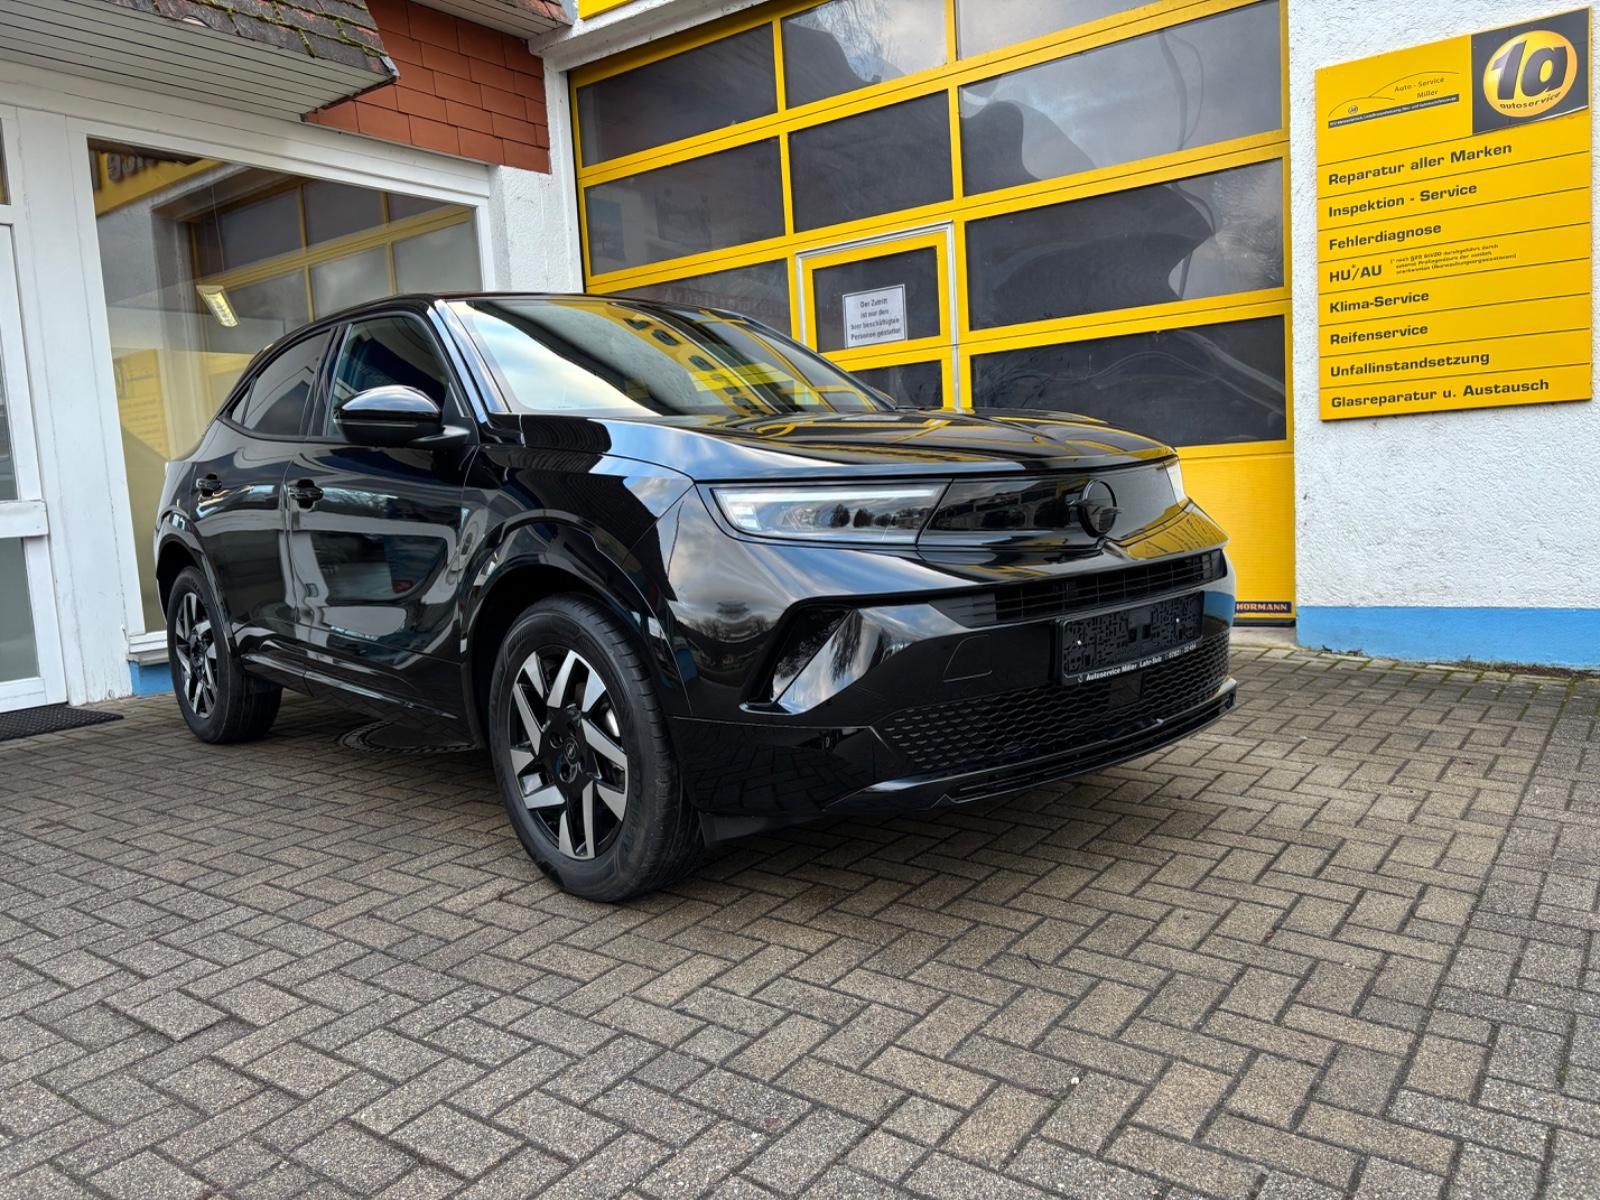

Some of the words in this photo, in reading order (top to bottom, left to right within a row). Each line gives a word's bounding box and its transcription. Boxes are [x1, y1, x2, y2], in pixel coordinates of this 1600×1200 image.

[1491, 40, 1569, 100] 1a
[1394, 83, 1412, 93] Auto
[1418, 77, 1445, 88] Service
[1416, 90, 1438, 99] Miller
[1499, 91, 1561, 110] autoservice
[1328, 164, 1405, 186] Reparatur
[1410, 155, 1445, 171] aller
[1450, 144, 1512, 163] Marken
[1328, 195, 1405, 218] Inspektion
[1420, 183, 1477, 202] Service
[1329, 223, 1442, 250] Fehlerdiagnose
[1329, 291, 1430, 314] Klima-Service
[1330, 324, 1429, 345] Reifenservice
[1330, 351, 1490, 378] Unfallinstandsetzung
[1331, 387, 1437, 409] Glasreparatur
[1442, 387, 1457, 399] u.
[1463, 378, 1549, 397] Austausch
[1086, 667, 1121, 681] Autoservice
[1122, 663, 1138, 673] Miller
